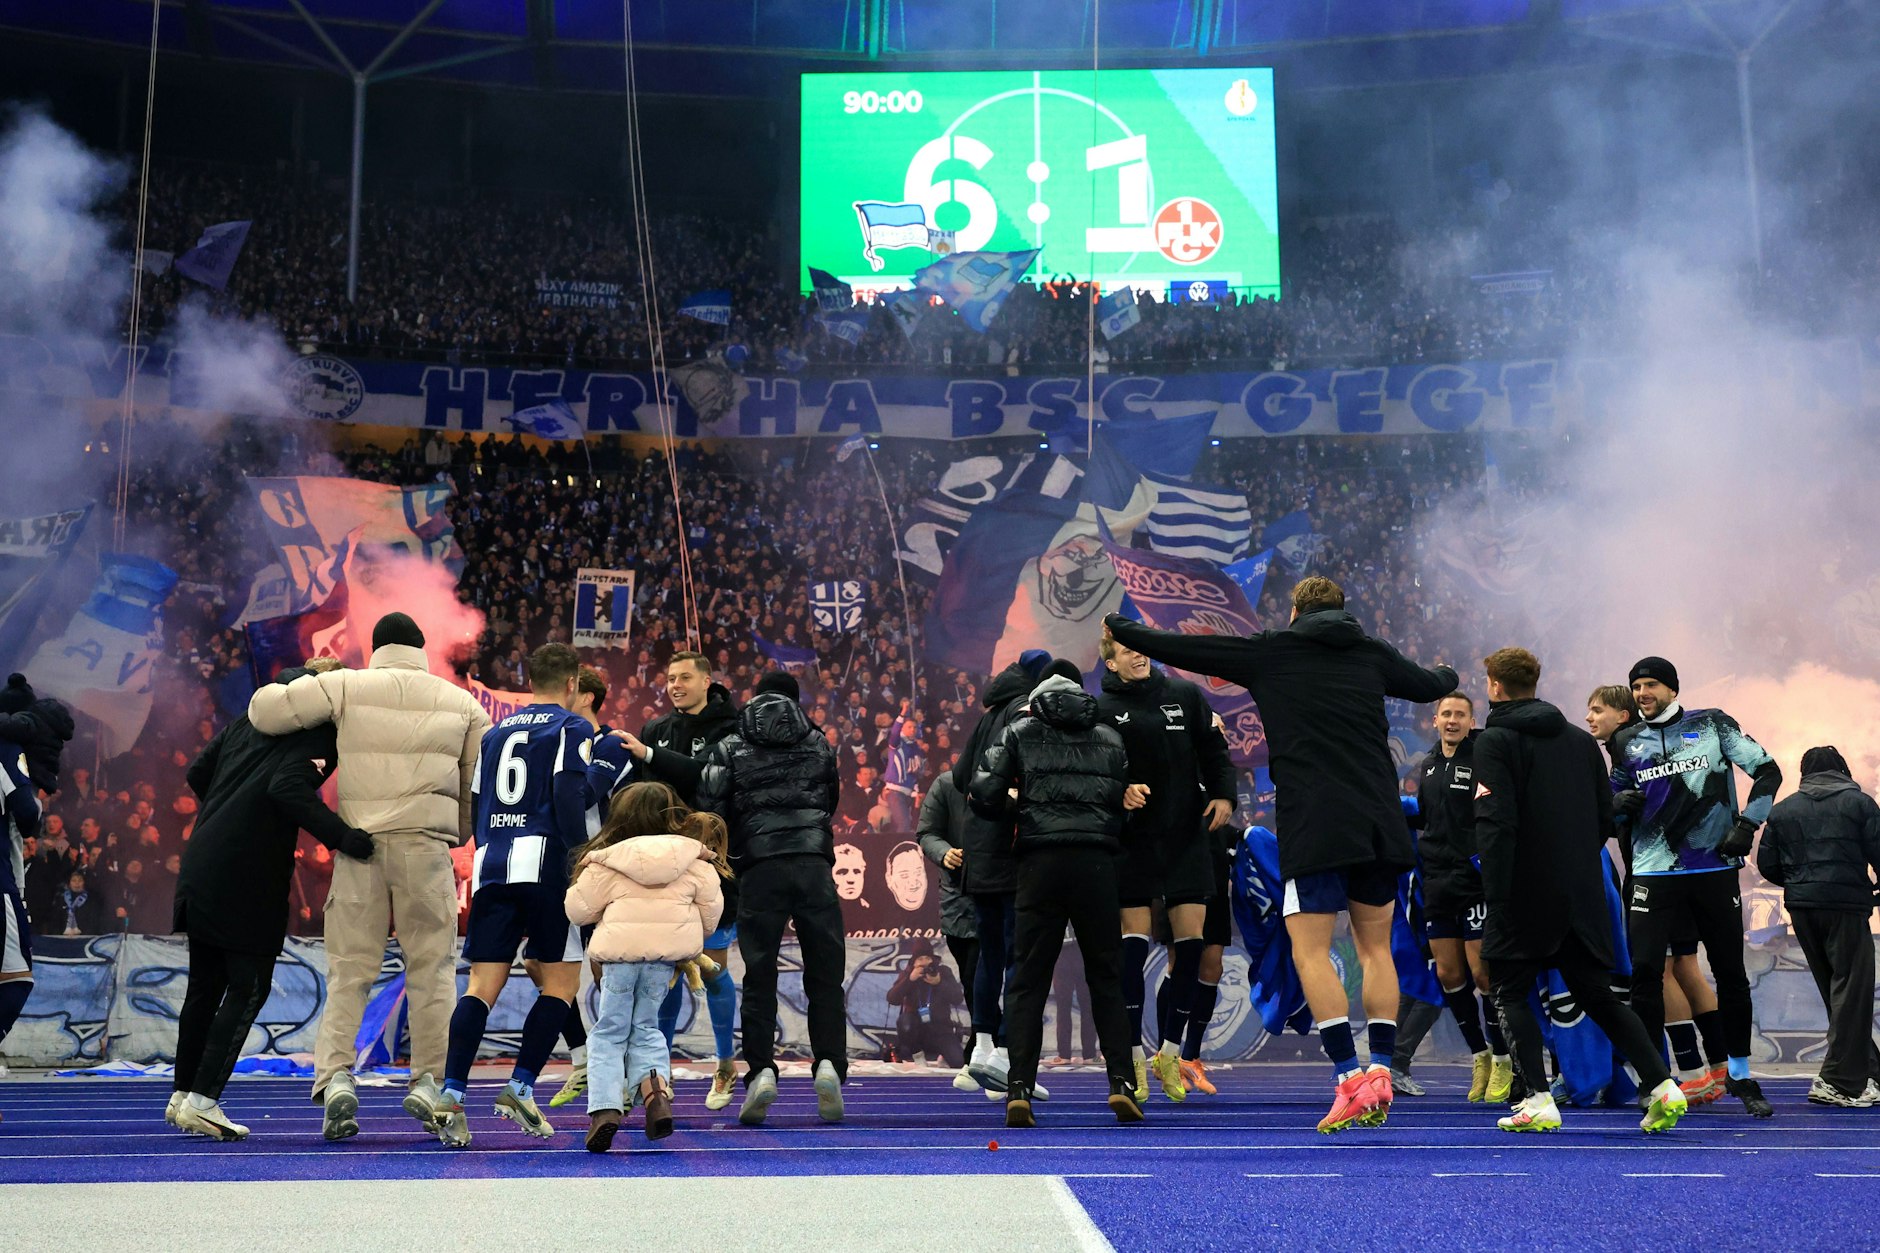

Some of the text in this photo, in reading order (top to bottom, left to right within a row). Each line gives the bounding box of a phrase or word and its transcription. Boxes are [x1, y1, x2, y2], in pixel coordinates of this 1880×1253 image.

[843, 89, 923, 114] 90:00
[903, 135, 998, 256] 6
[1086, 134, 1160, 253] 1
[535, 279, 624, 296] SEXY AMAZIN
[945, 378, 1164, 440] BSC
[1241, 361, 1575, 436] GEGE
[578, 574, 629, 585] LAUTSTARK
[499, 713, 554, 729] HERTHA BSC
[495, 730, 529, 806] 6
[1635, 755, 1709, 783] CHECKCARS24
[489, 813, 528, 828] DEMME
